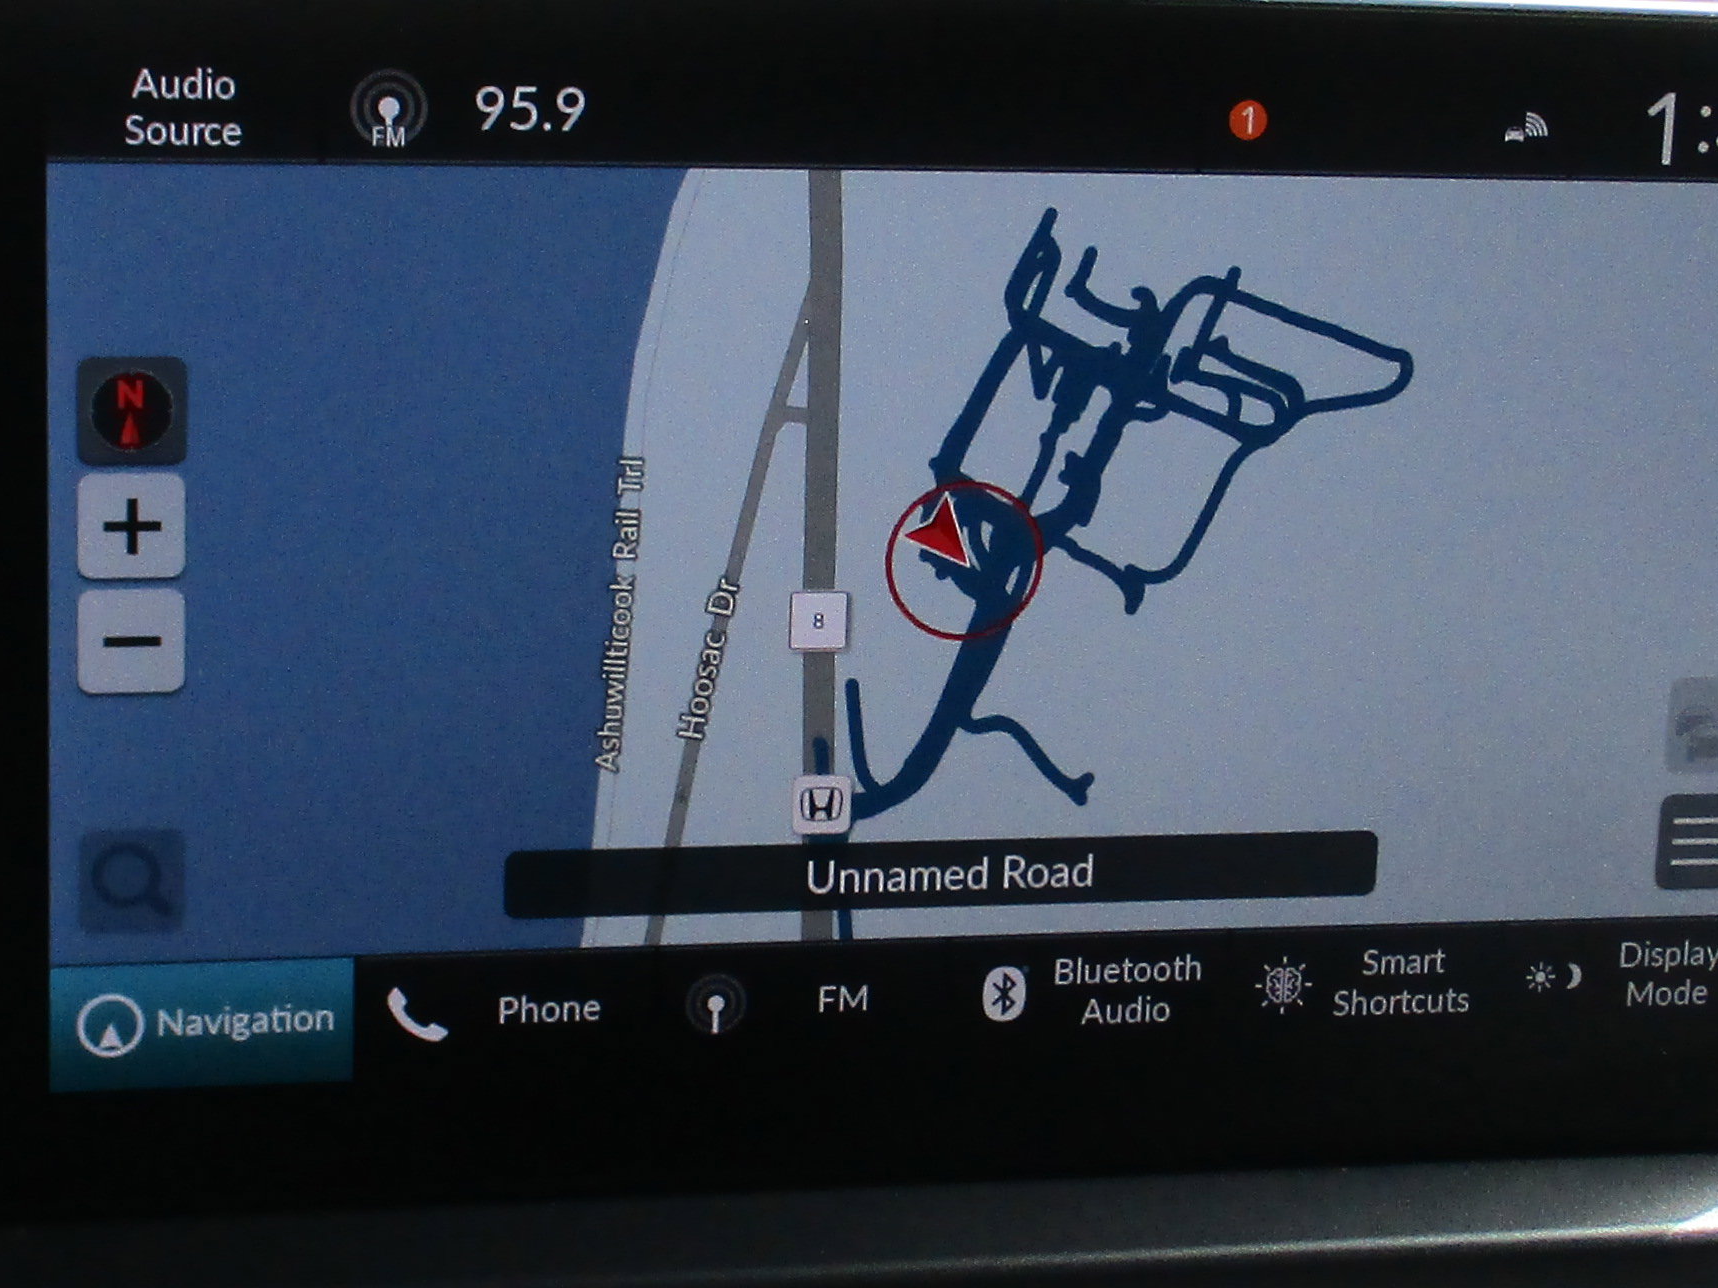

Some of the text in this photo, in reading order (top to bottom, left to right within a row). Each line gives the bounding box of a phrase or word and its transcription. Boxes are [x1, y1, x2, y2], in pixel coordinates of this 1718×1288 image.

[131, 67, 236, 100] Audio
[475, 85, 586, 132] 95.9
[1241, 106, 1254, 135] 1
[125, 114, 243, 147] Source
[372, 123, 406, 148] FM
[117, 379, 144, 408] N
[595, 457, 644, 773] Ashuwillticook Rail Trl
[814, 614, 823, 629] 8
[677, 577, 738, 740] Hoosac Dr
[807, 853, 1094, 895] Unnamed Road
[1054, 953, 1202, 985] Bluetooth
[1362, 948, 1446, 976] Smart
[818, 984, 868, 1013] FM
[1332, 987, 1469, 1017] Shortcuts
[1626, 978, 1708, 1007] Mode
[157, 1001, 335, 1041] Navigation
[498, 994, 601, 1025] Phone
[1081, 995, 1171, 1025] Audio
